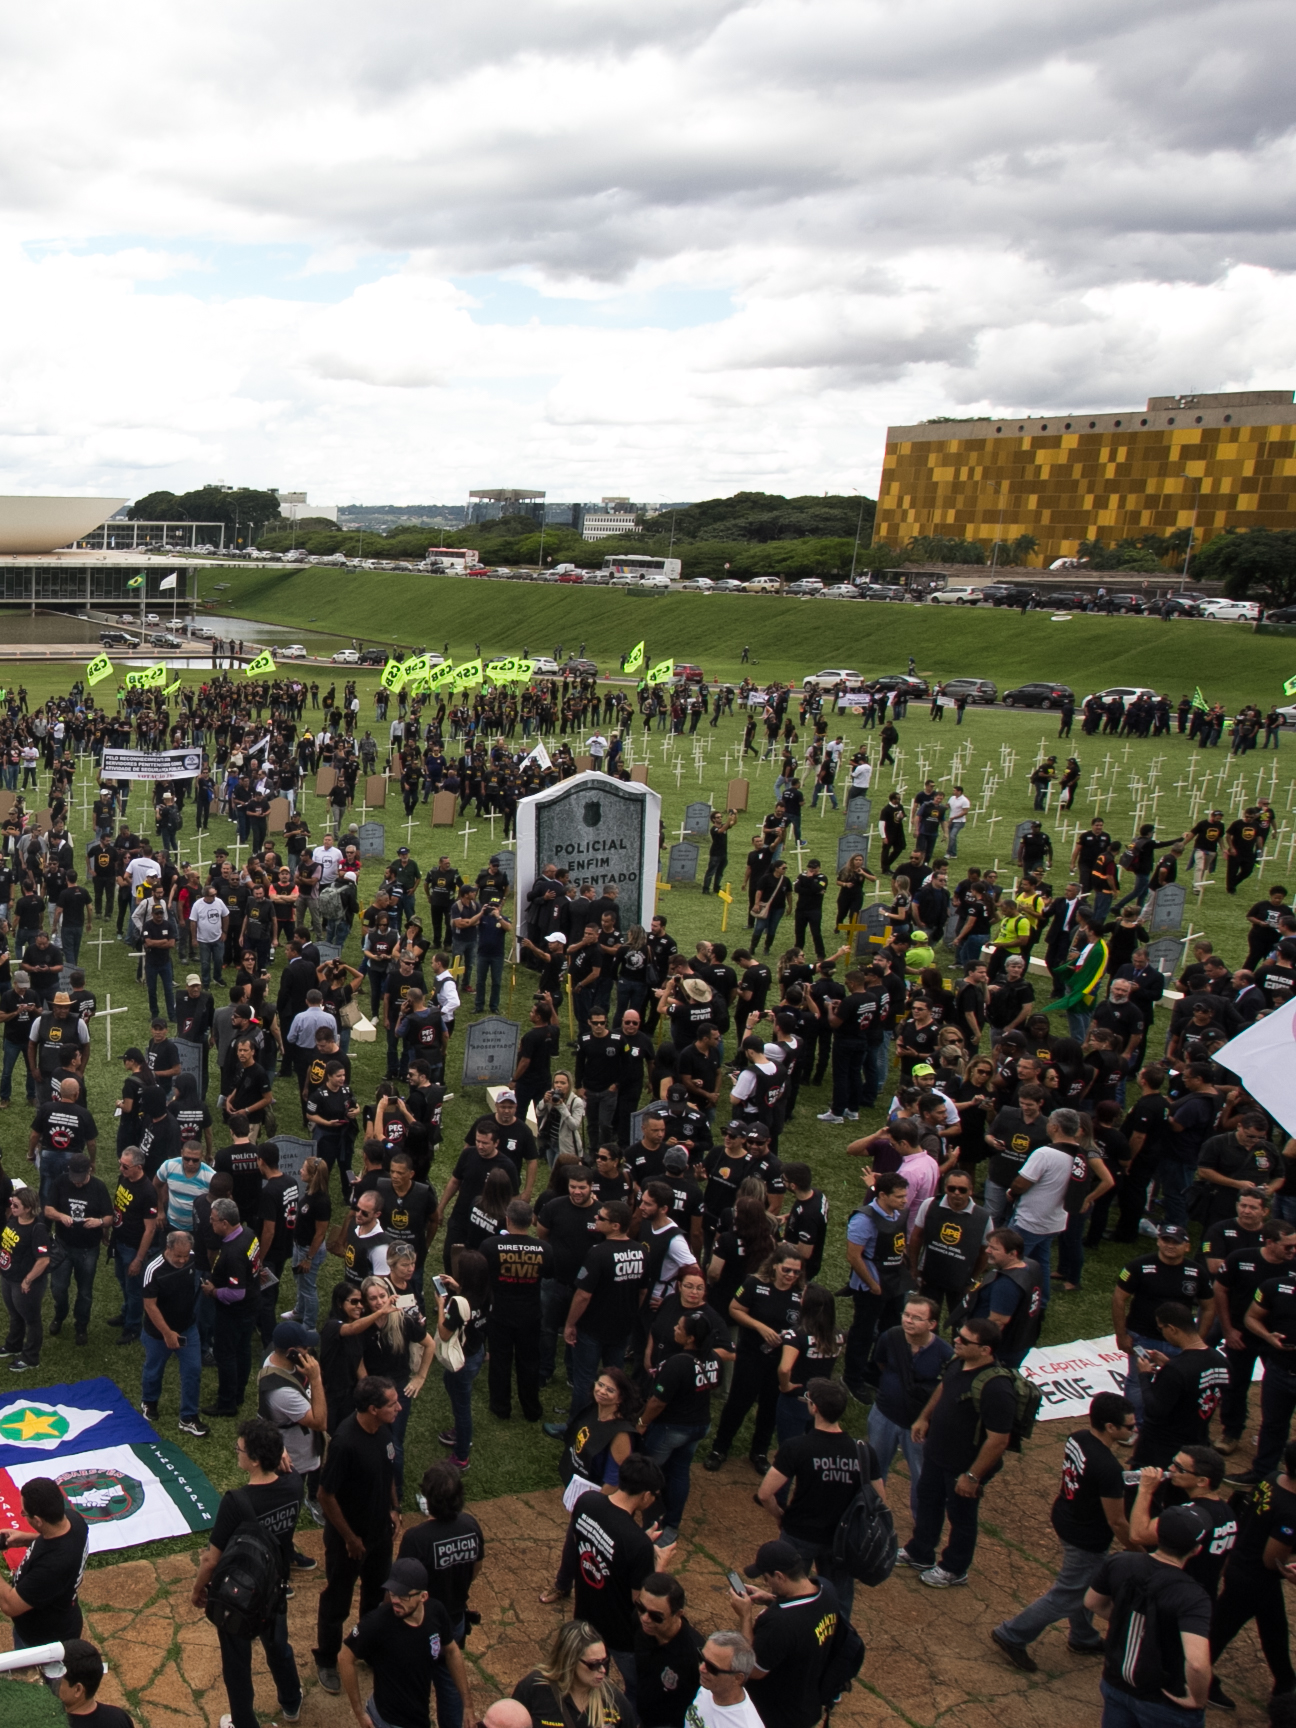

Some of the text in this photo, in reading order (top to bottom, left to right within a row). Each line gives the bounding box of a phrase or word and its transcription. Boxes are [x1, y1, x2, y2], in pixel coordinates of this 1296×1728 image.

[554, 838, 627, 856] POLICIAL
[567, 857, 610, 871] ENFIM
[1266, 973, 1294, 984] POLÍCIA
[690, 1007, 711, 1015] POLÍCIA
[690, 1013, 711, 1021] CIVIL
[388, 1124, 403, 1132] PEC
[1012, 1137, 1030, 1147] UPB
[472, 1205, 498, 1226] POLÍCIA
[469, 1212, 496, 1234] CIVIL
[943, 1226, 962, 1239] UPB
[497, 1243, 544, 1252] DIRETORIA
[499, 1250, 544, 1265] POLÍCIA
[613, 1249, 644, 1263] POLÍCIA
[501, 1263, 539, 1277] CIVIL
[615, 1260, 644, 1276] CIVIL
[1039, 1356, 1102, 1376] CAPITAL
[813, 1454, 860, 1472] POLÍCIA
[822, 1470, 853, 1484] CIVIL
[260, 1506, 296, 1527] POLÍCIA
[438, 1538, 477, 1556] POLÍCIA
[439, 1551, 478, 1567] CIVIL
